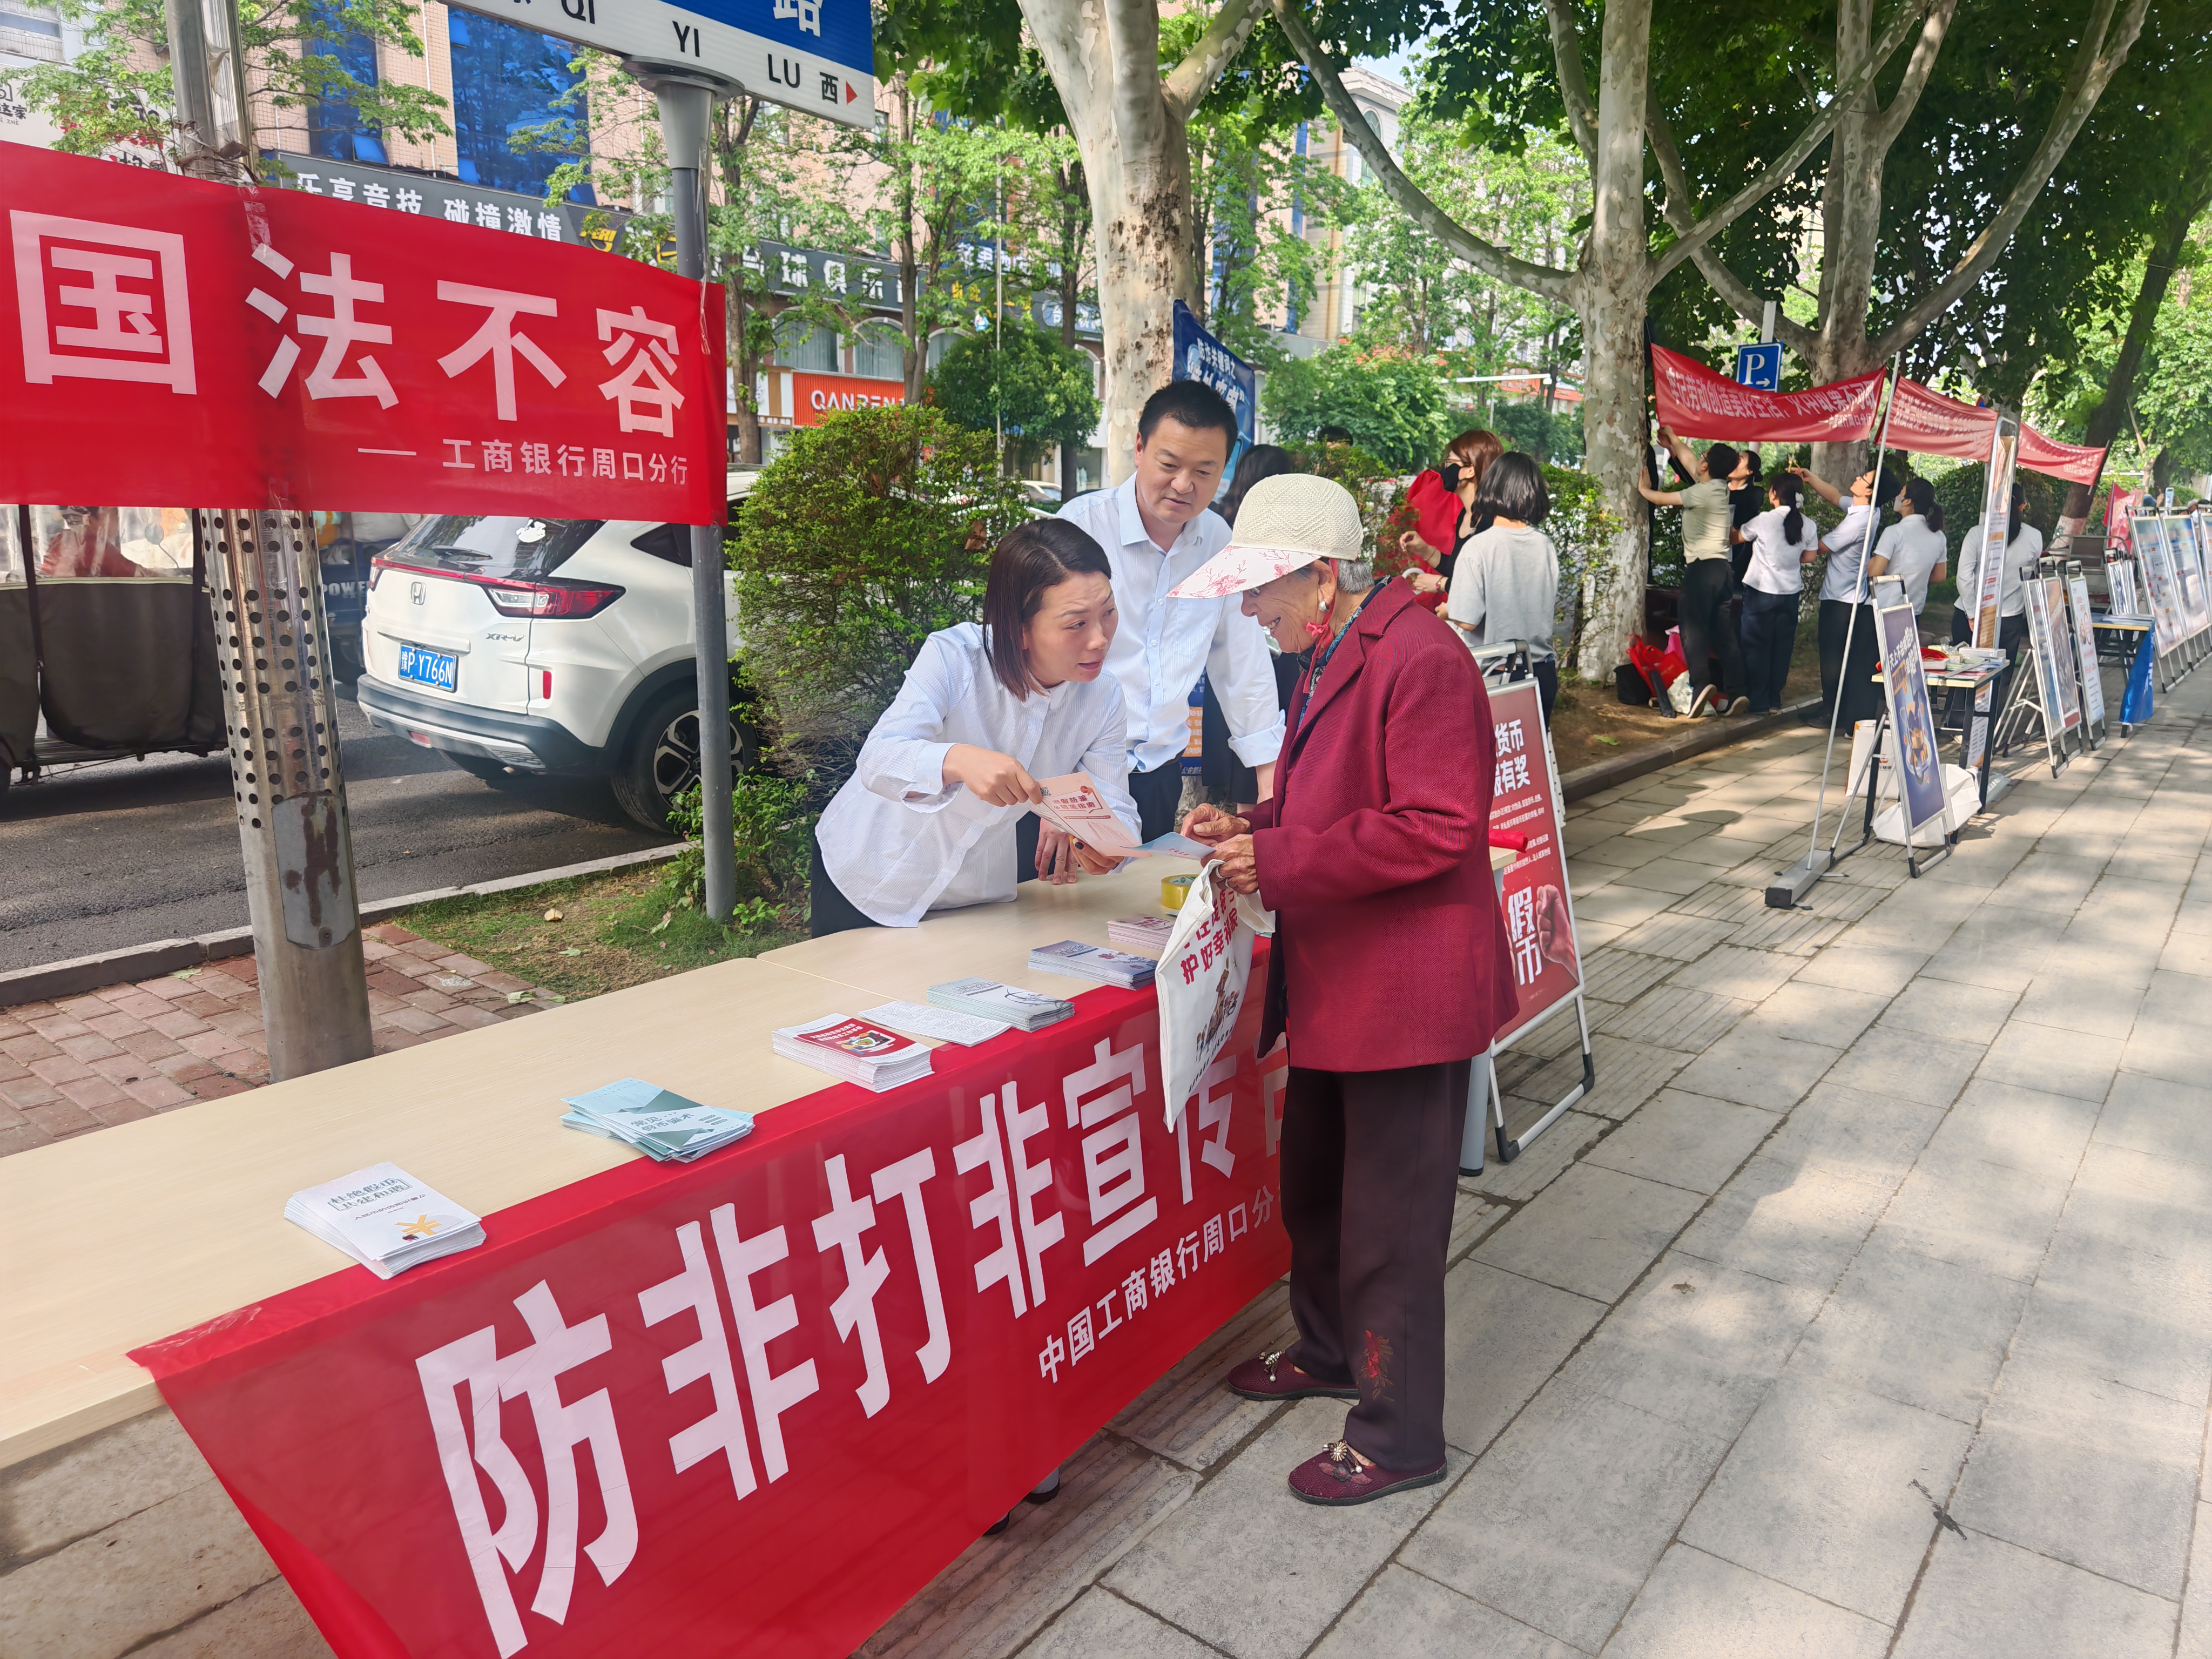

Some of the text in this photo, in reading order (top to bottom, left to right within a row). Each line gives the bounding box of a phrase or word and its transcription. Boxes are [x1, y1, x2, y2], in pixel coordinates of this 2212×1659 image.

[672, 20, 700, 58] YI
[767, 53, 801, 89] LU
[819, 71, 839, 105] 西
[443, 198, 562, 242] 碰撞激情
[9, 210, 685, 438] 国法不容
[1744, 353, 1765, 385] P
[811, 389, 905, 411] QANREN
[1494, 718, 1525, 758] 货币
[1180, 907, 1238, 986] 护好幸福家
[1507, 886, 1542, 986] 假币
[630, 1116, 663, 1127] 常见
[641, 1112, 695, 1131] 假币骗术
[329, 1178, 399, 1204] 杜绝假币
[339, 1183, 406, 1210] 共建和谐
[1038, 1185, 1281, 1384] 中国工商银行周口分
